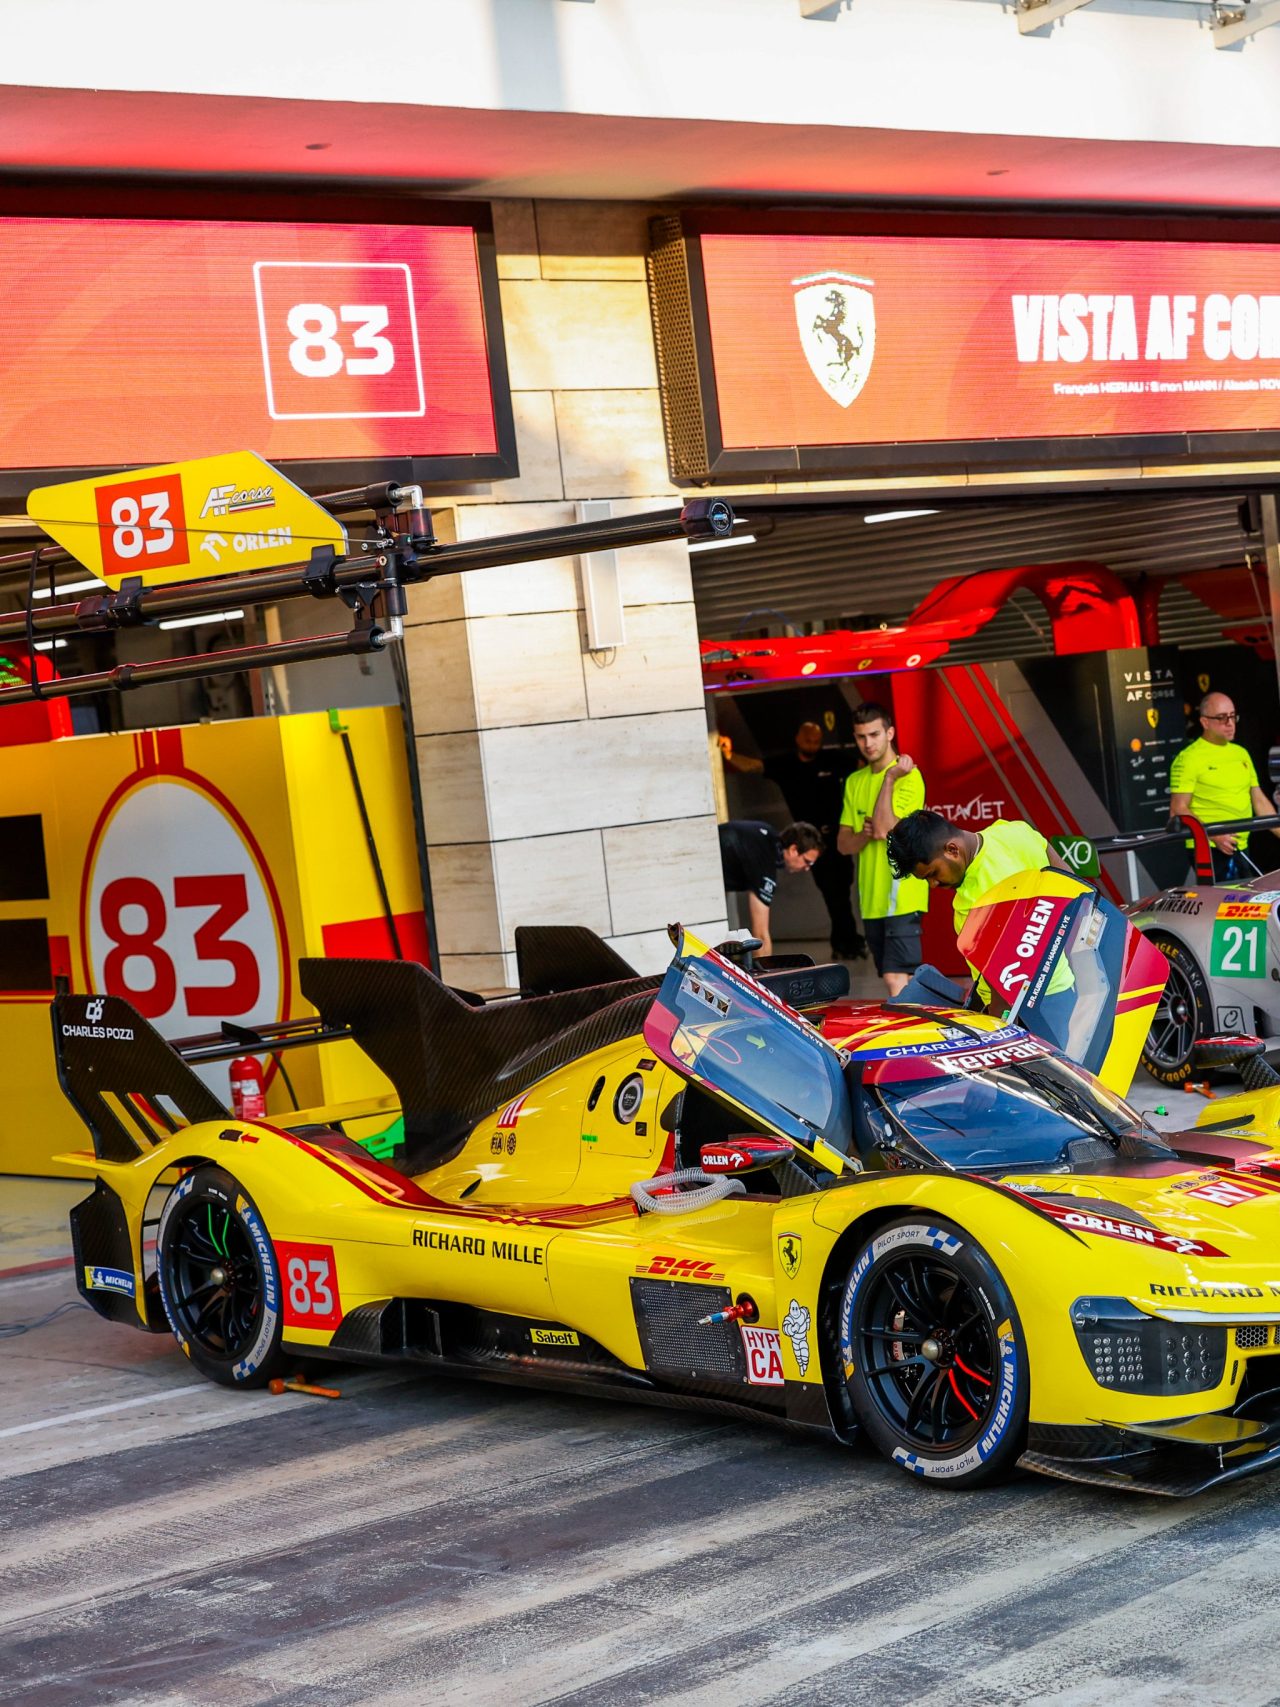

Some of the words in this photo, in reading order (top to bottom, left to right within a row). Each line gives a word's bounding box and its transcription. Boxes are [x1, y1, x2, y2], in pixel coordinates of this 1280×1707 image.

[287, 303, 395, 377] 83
[1011, 293, 1139, 362] VISTA
[1144, 294, 1197, 360] AF
[110, 491, 174, 558] 83
[232, 526, 293, 554] ORLEN
[1124, 669, 1174, 683] VISTA
[1126, 690, 1143, 702] AF
[1145, 688, 1176, 700] CORSE
[1225, 905, 1262, 918] DHL
[1016, 899, 1055, 958] ORLEN
[99, 873, 260, 1019] 83
[1220, 925, 1258, 972] 21
[62, 1023, 106, 1039] CHARLES
[106, 1026, 134, 1041] POZZI
[885, 1037, 981, 1057] CHARLES
[981, 1028, 1019, 1045] POZZI
[702, 1155, 729, 1166] ORLEN
[1188, 1181, 1257, 1206] HY
[877, 1234, 897, 1251] PILOT
[896, 1229, 921, 1240] SPORT
[1064, 1213, 1155, 1243] ORLEN
[412, 1229, 487, 1257] RICHARD
[491, 1240, 544, 1265] MILLE
[249, 1222, 276, 1305] MICHELIN
[648, 1255, 717, 1280] DHL
[105, 1275, 133, 1290] MICHELIN
[287, 1256, 335, 1315] 83
[841, 1250, 871, 1342] MICHELIN
[1149, 1282, 1264, 1299] RICHARD
[261, 1315, 273, 1337] PILOT
[535, 1330, 575, 1345] Sabelt
[751, 1348, 784, 1380] CA
[981, 1361, 1014, 1454] MICHELIN
[930, 1464, 954, 1474] SPORT
[955, 1454, 976, 1471] PILOT
